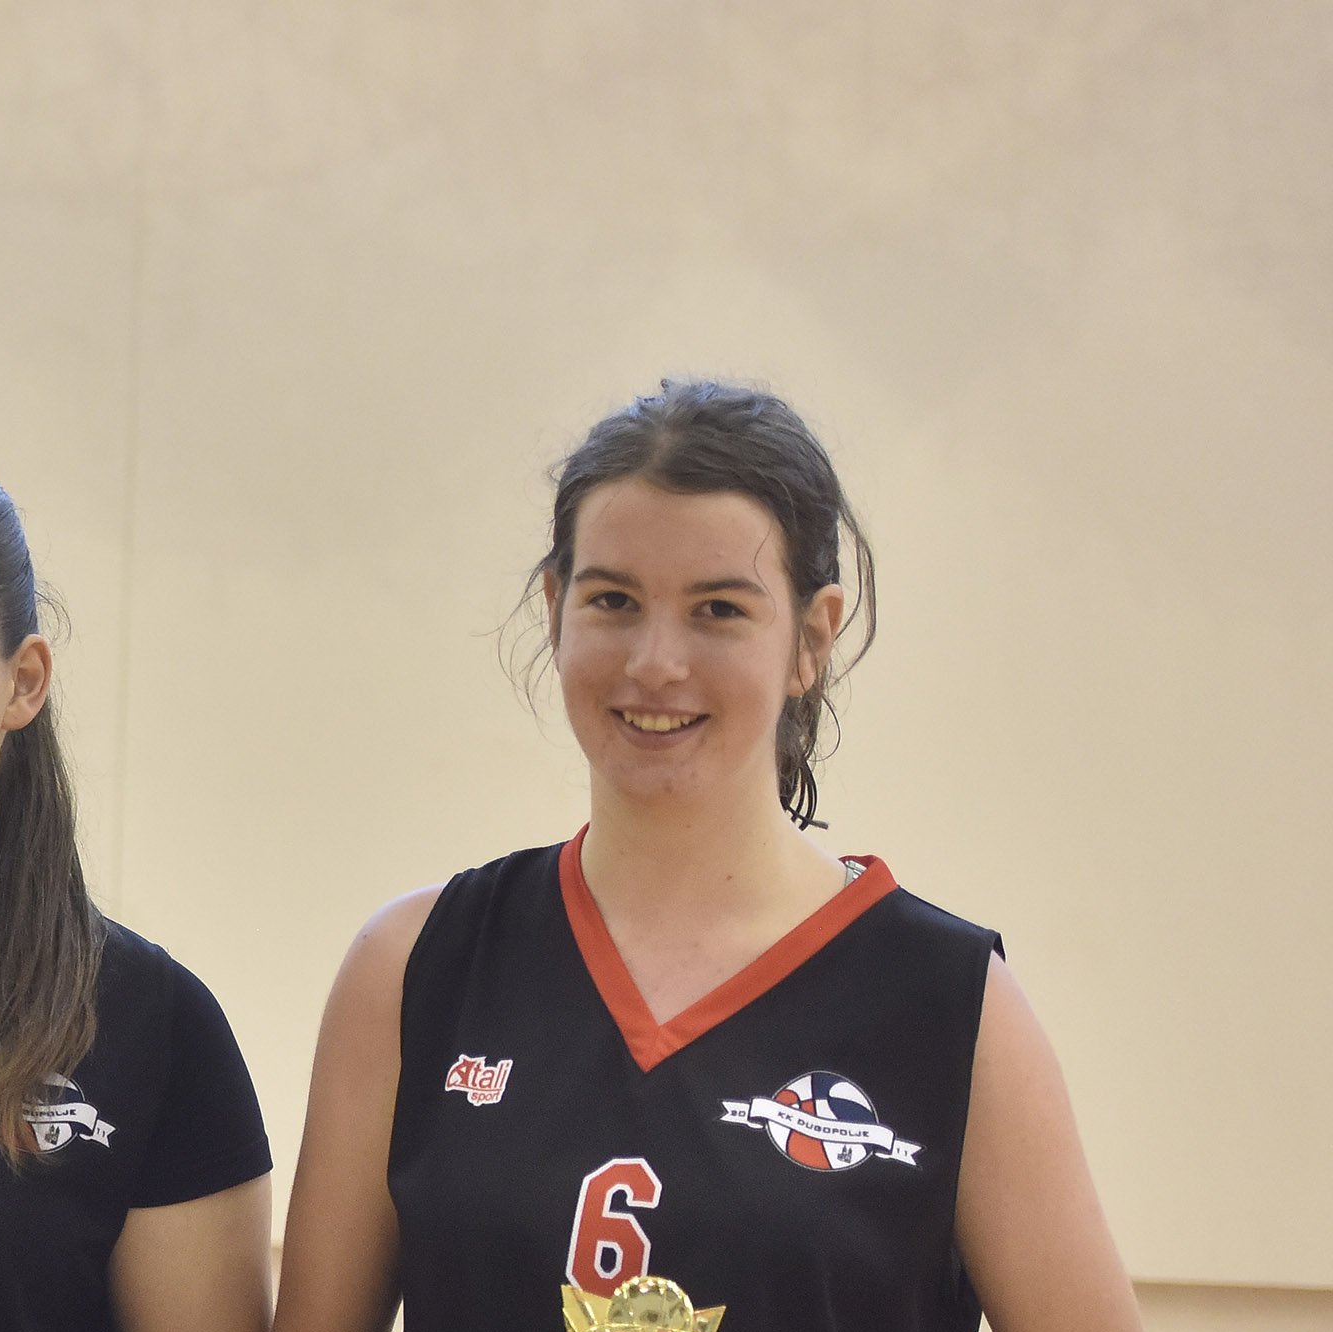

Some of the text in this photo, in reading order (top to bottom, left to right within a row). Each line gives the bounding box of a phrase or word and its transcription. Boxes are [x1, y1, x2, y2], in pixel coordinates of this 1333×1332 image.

[447, 1058, 510, 1089] Atali
[470, 1091, 500, 1104] sport
[730, 1109, 746, 1118] 20
[777, 1111, 870, 1138] KK DUGOPOLJE
[896, 1147, 908, 1157] 11
[565, 1157, 663, 1294] 6
